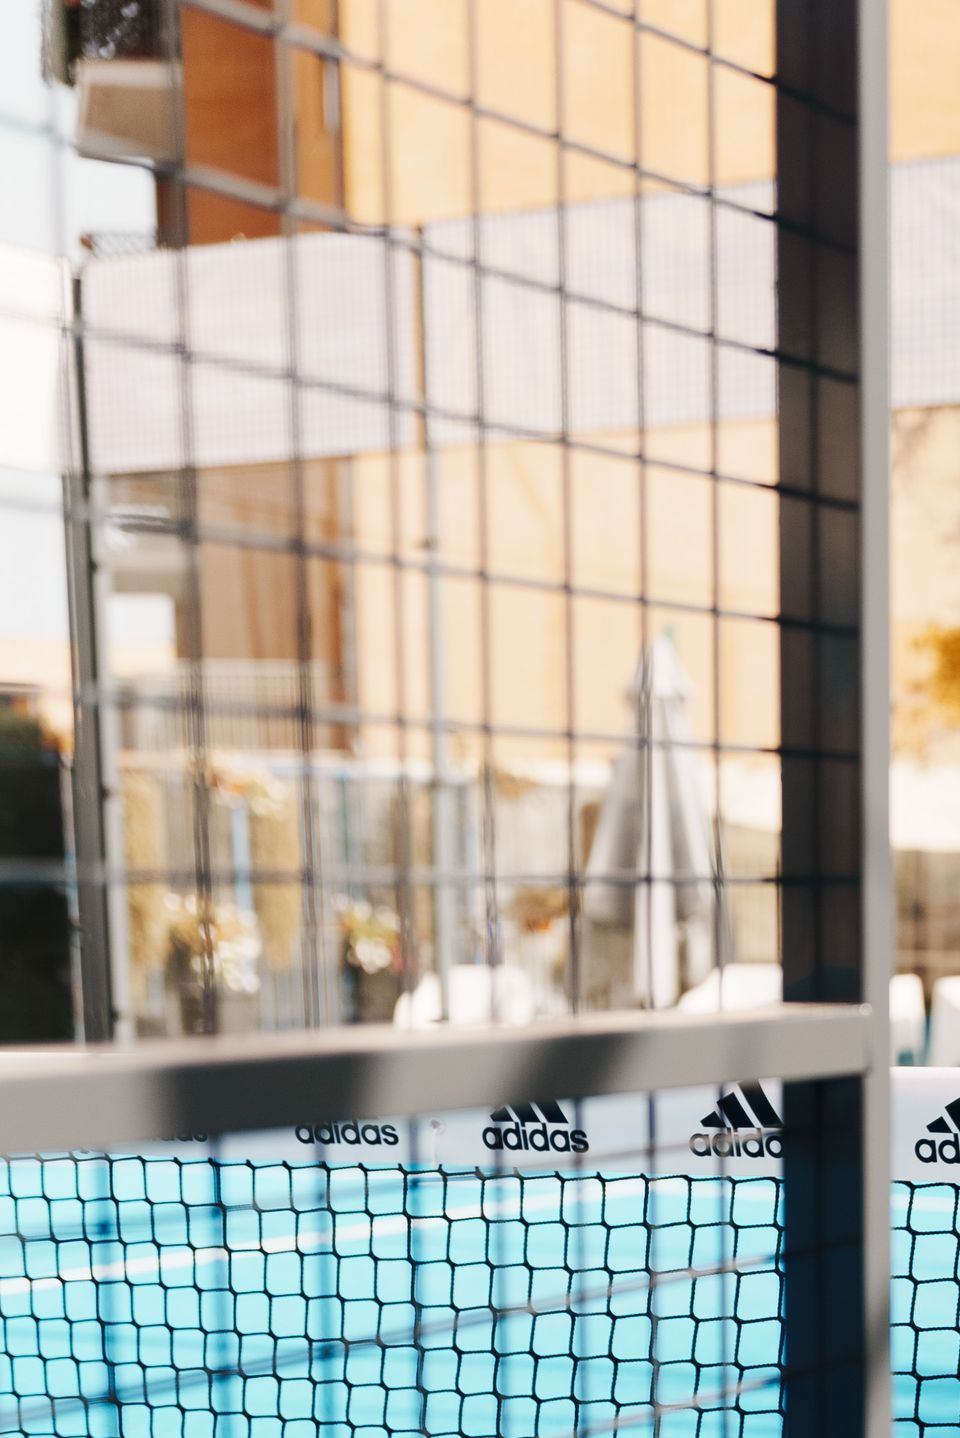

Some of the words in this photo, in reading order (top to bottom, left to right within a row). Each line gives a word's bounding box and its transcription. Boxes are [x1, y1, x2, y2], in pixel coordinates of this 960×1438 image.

[295, 1120, 399, 1146] adidas
[482, 1121, 589, 1153] adidas
[689, 1127, 783, 1158] adida
